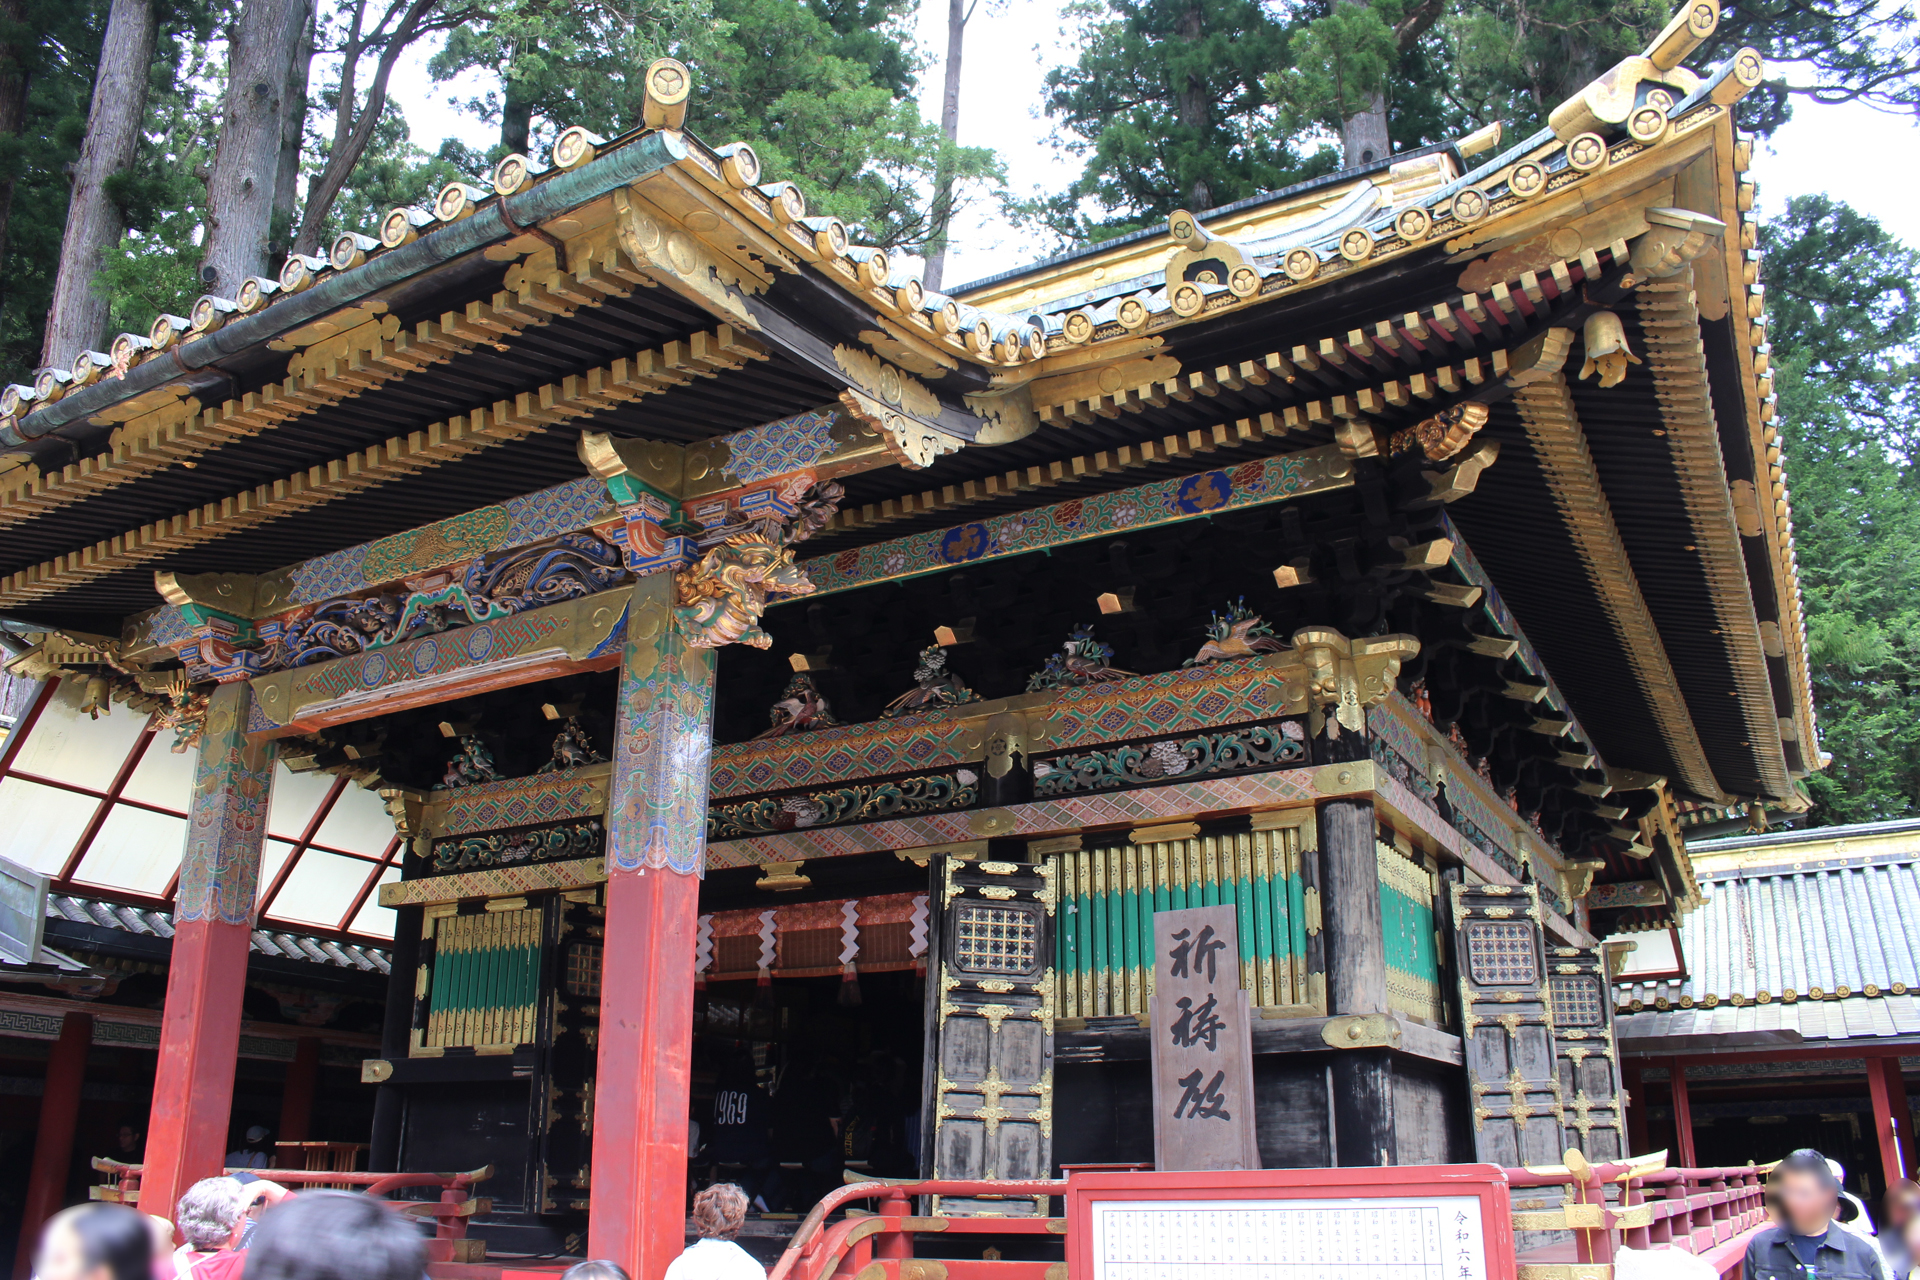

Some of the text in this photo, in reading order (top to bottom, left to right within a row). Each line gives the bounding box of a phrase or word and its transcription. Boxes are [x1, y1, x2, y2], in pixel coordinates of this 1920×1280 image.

[1170, 925, 1231, 1122] 祈祷殿
[713, 1090, 748, 1125] 1969
[1453, 1210, 1473, 1280] 令和六年
